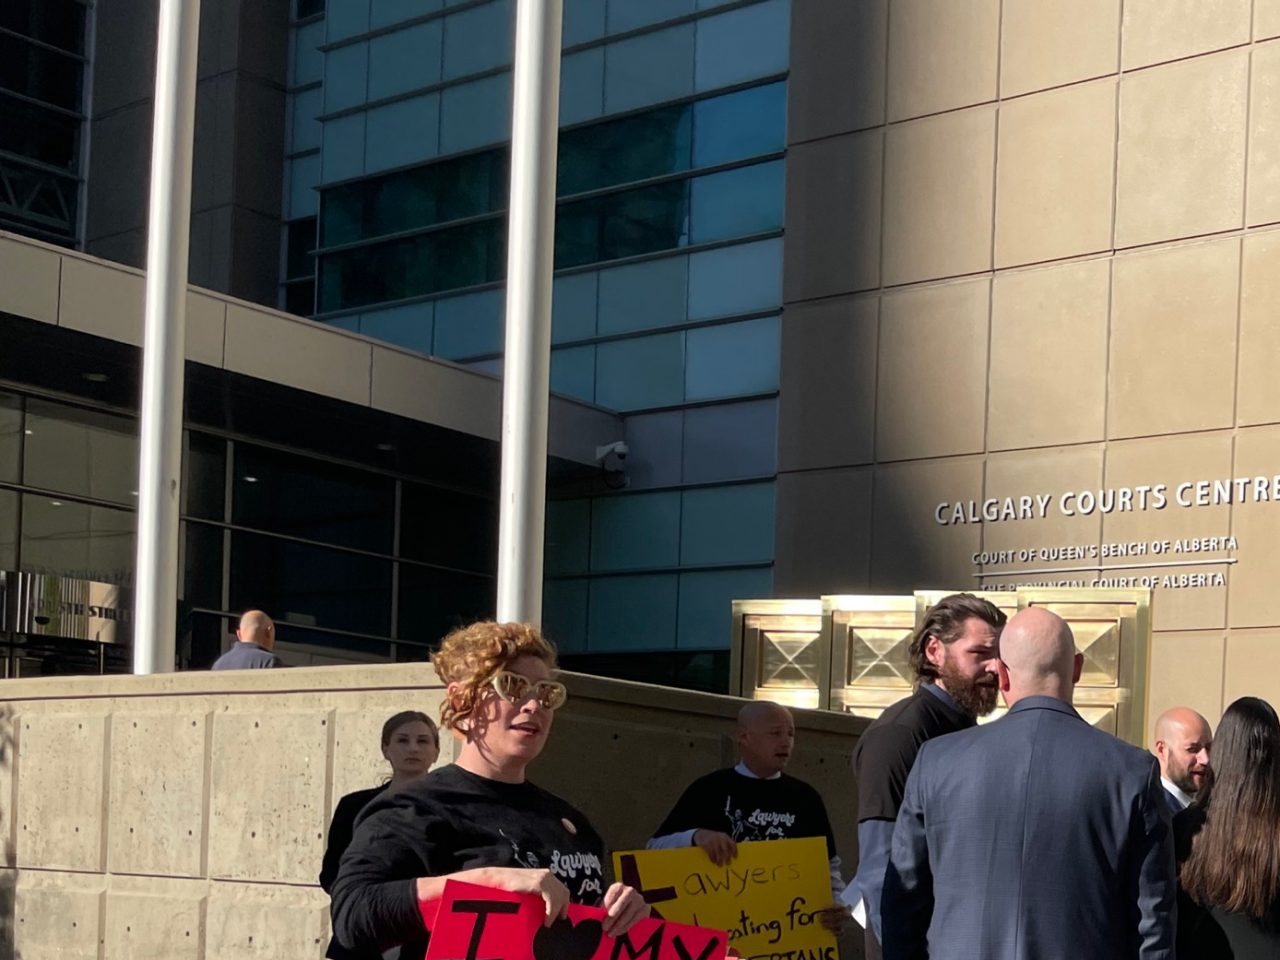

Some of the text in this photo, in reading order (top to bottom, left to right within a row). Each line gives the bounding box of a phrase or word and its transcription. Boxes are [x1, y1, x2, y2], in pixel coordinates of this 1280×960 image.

[935, 494, 1051, 525] CALGARY
[1059, 484, 1167, 515] COURTS
[971, 536, 1239, 565] COURT OF QUEEN'S BENCH OF ALBERTA
[1089, 576, 1139, 589] COURT
[1141, 575, 1161, 589] OF
[1163, 572, 1227, 588] ALBERTA
[620, 854, 800, 904] Lawyers
[787, 897, 830, 931] for
